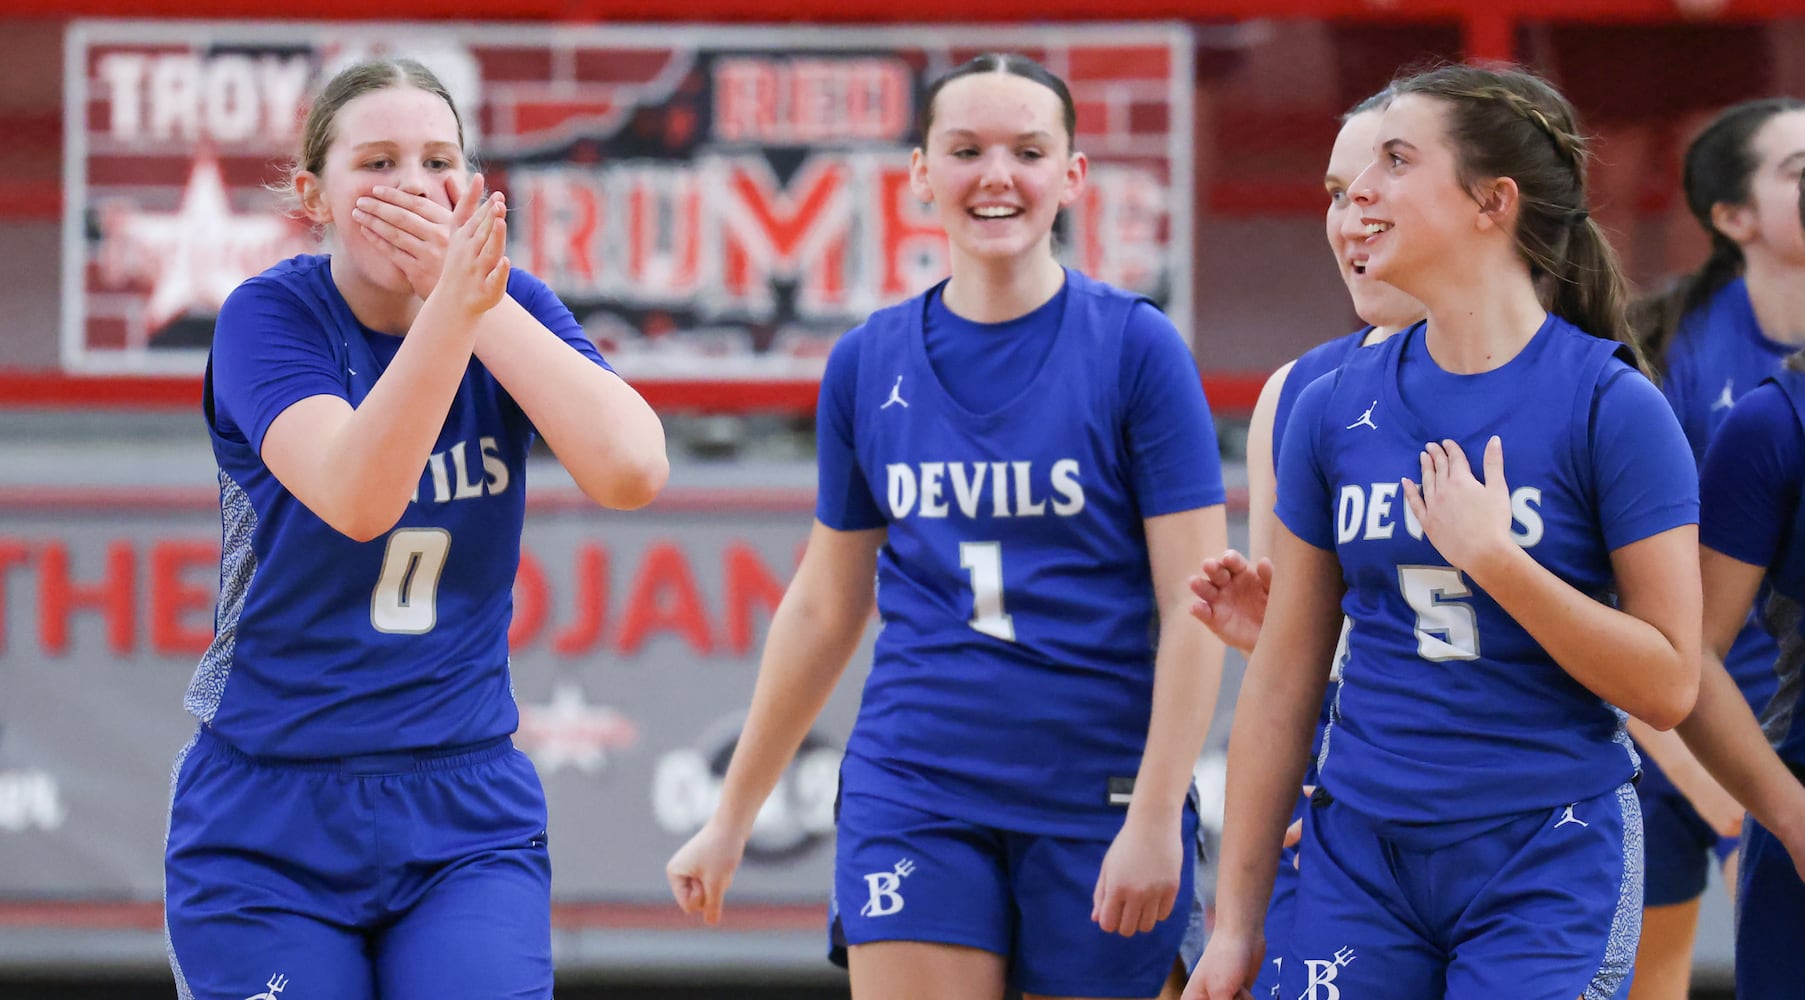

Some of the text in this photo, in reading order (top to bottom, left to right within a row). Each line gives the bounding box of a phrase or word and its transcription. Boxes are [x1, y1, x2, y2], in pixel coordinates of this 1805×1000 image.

[99, 51, 309, 143] TROY
[510, 152, 1167, 320] RUMBE
[411, 436, 510, 503] ILS
[886, 459, 1086, 519] DEVILS
[1337, 482, 1545, 549] DES
[370, 527, 452, 635] 0
[959, 540, 1016, 642] 1
[1397, 564, 1480, 662] 5
[861, 868, 906, 917] B
